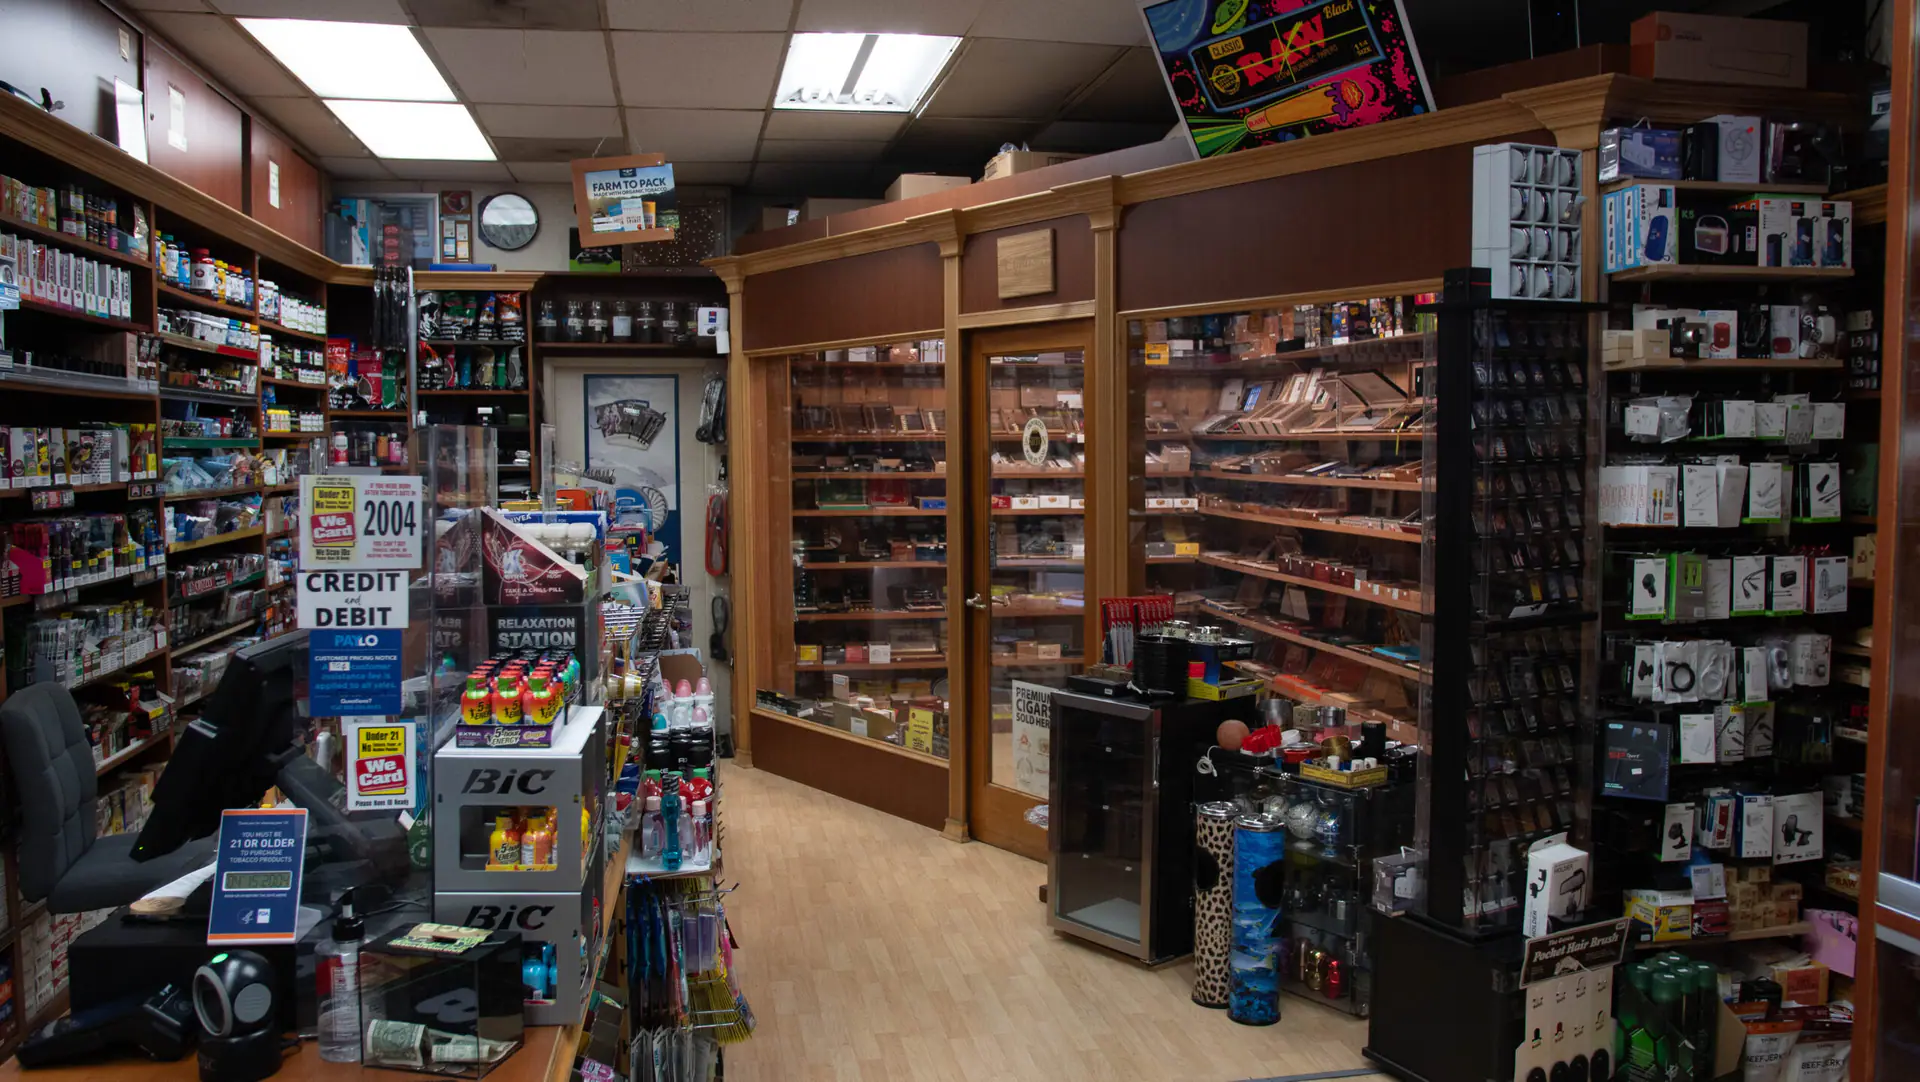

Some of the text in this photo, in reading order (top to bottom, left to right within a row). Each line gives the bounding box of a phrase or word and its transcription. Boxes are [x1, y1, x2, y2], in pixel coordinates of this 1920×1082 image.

[1322, 0, 1355, 20] Black
[1212, 38, 1243, 58] CLASSIC
[1235, 12, 1326, 87] RAW
[593, 177, 666, 192] FARM TO PACK
[319, 490, 350, 499] Under 21
[318, 515, 347, 527] We
[363, 500, 416, 536] 2004
[313, 525, 354, 539] Card
[316, 549, 326, 557] We
[326, 549, 340, 557] Scan
[306, 572, 401, 592] CREDIT
[344, 595, 362, 605] and
[316, 607, 392, 627] DEBIT
[497, 617, 576, 629] RELAXATION
[334, 634, 379, 647] PAYLO
[497, 631, 577, 648] STATION
[1015, 711, 1035, 725] SOLD
[366, 731, 399, 741] Under 21
[492, 736, 520, 745] ENERGY
[362, 743, 372, 752] No
[365, 759, 397, 773] We
[358, 769, 405, 786] Card
[230, 838, 296, 849] 21 OR OLDER
[1553, 863, 1574, 873] HOLDER
[1532, 945, 1566, 963] Pocket
[1566, 940, 1590, 954] Hair
[1590, 932, 1620, 948] Brush
